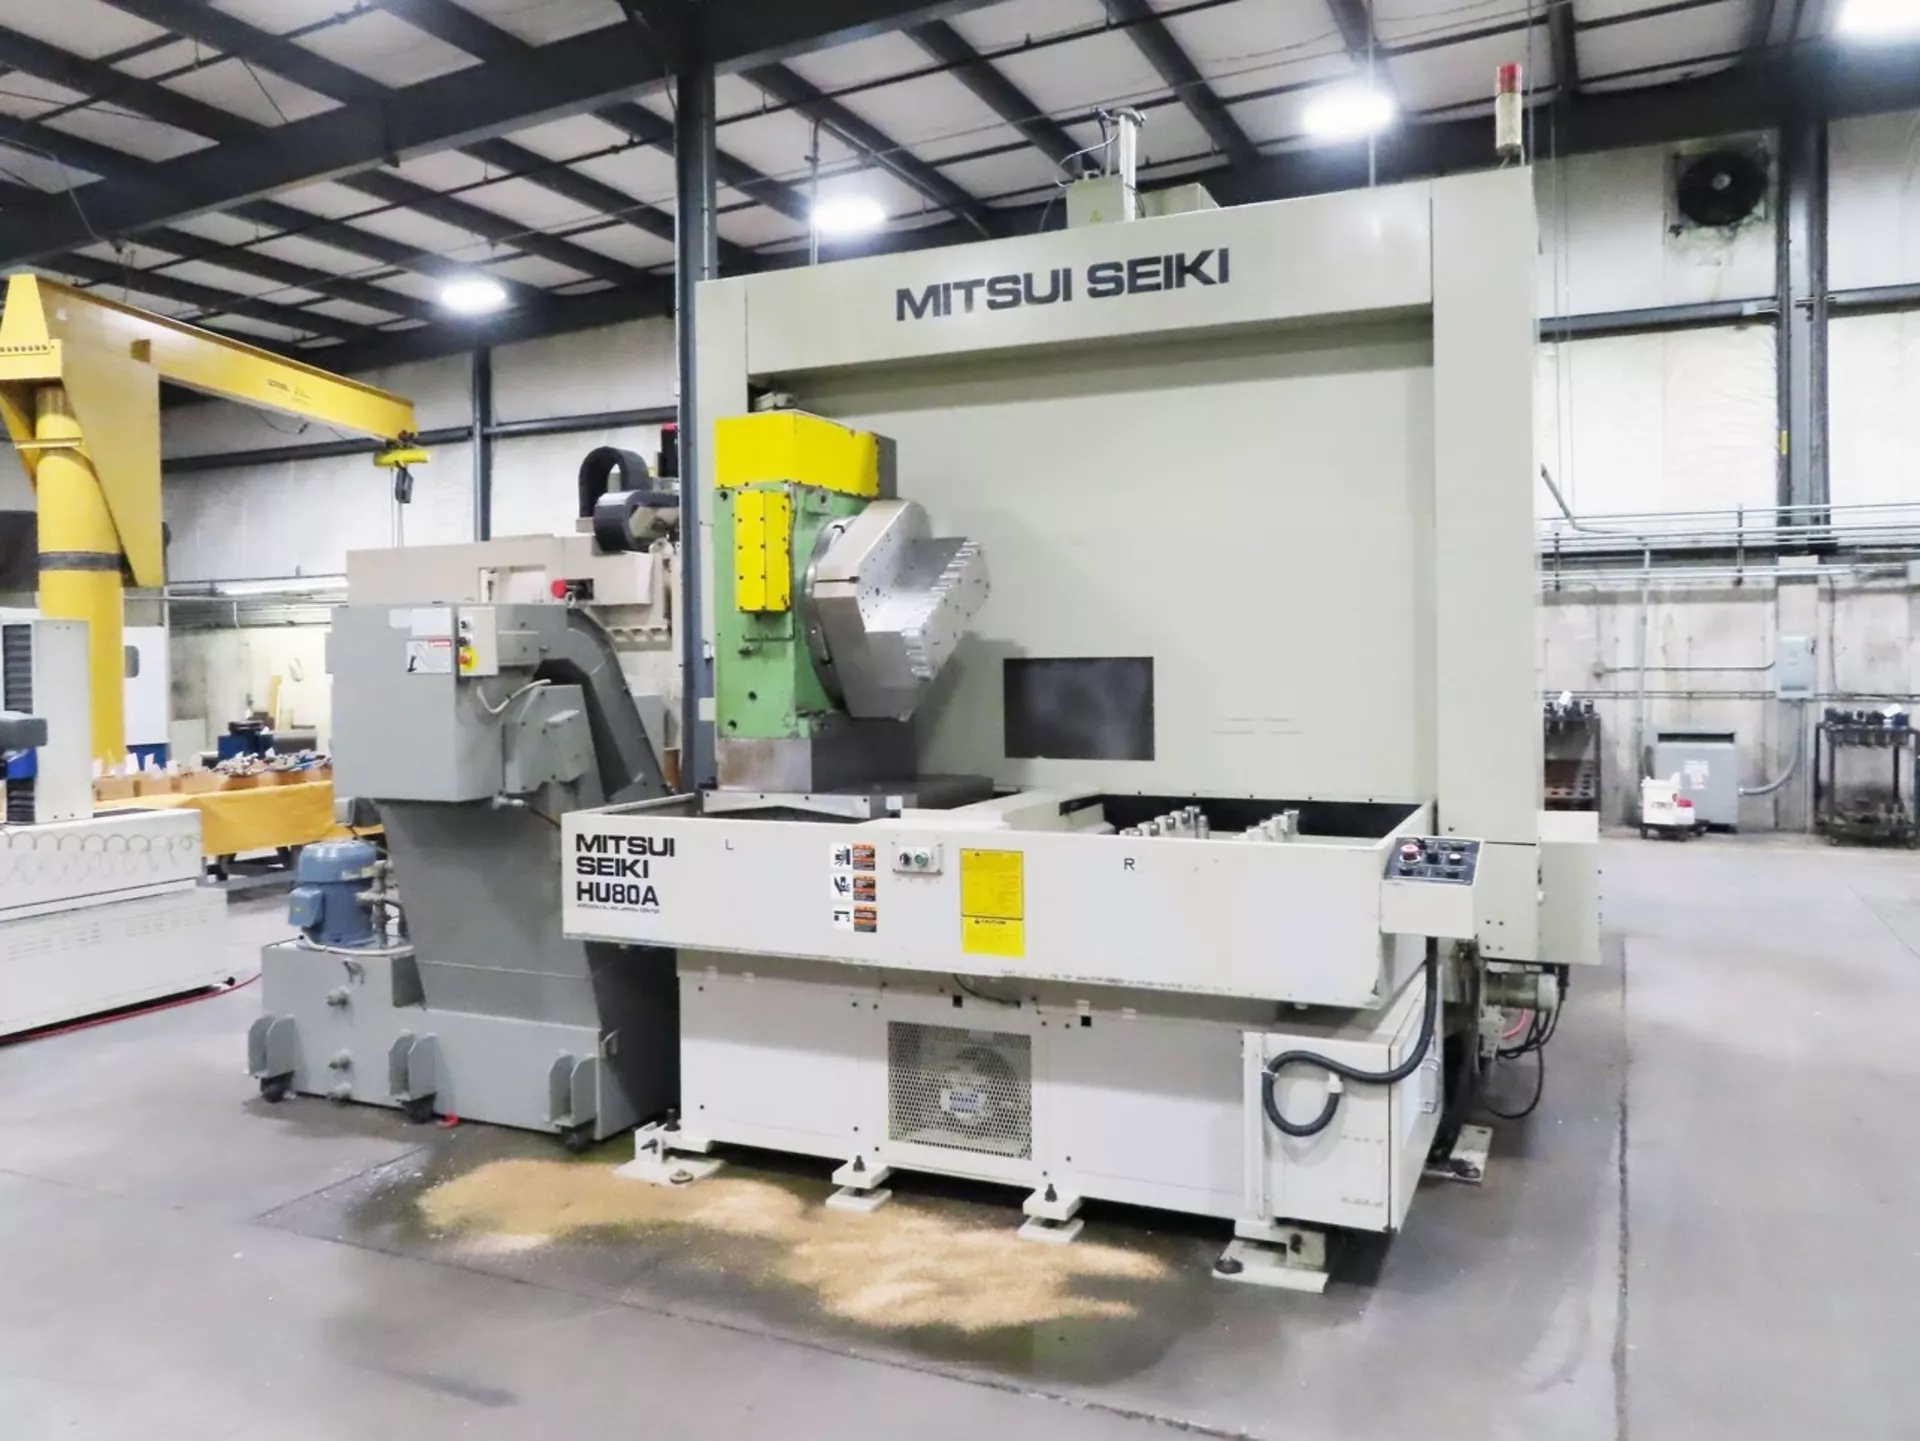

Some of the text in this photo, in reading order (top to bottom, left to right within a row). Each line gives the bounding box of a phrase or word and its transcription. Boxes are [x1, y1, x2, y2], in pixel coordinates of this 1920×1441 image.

[896, 247, 1230, 321] MITSUI SEIKI
[575, 833, 675, 857] MITSUI
[725, 838, 734, 851] L
[576, 856, 649, 879] SEIKI
[1123, 857, 1136, 871] R
[576, 880, 660, 907] HU80A
